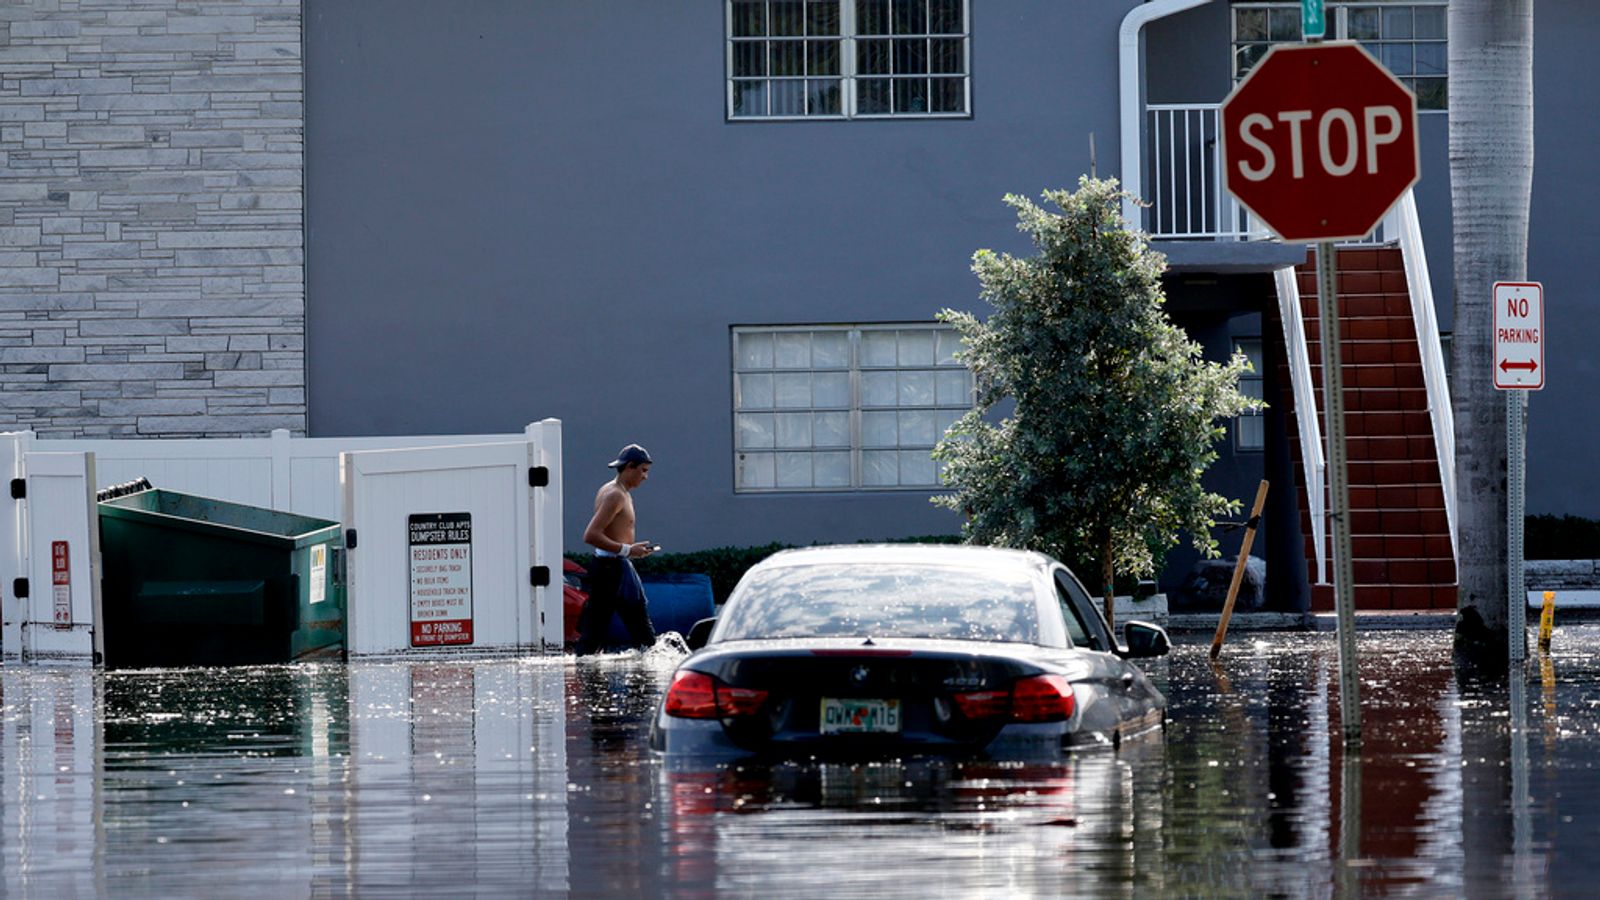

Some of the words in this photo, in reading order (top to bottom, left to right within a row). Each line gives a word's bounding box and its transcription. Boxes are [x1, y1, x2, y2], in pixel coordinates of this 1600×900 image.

[1237, 105, 1403, 182] STOP
[1508, 298, 1529, 318] NO
[1498, 328, 1539, 344] PARKING
[410, 522, 437, 530] COUNTRY
[456, 521, 470, 529] APTS
[411, 531, 446, 542] DUMPSTER
[448, 530, 470, 540] RULES
[414, 548, 448, 560] RESIDENTS
[450, 548, 468, 560] ONLY
[422, 624, 431, 634] NO
[434, 622, 462, 632] PARKING
